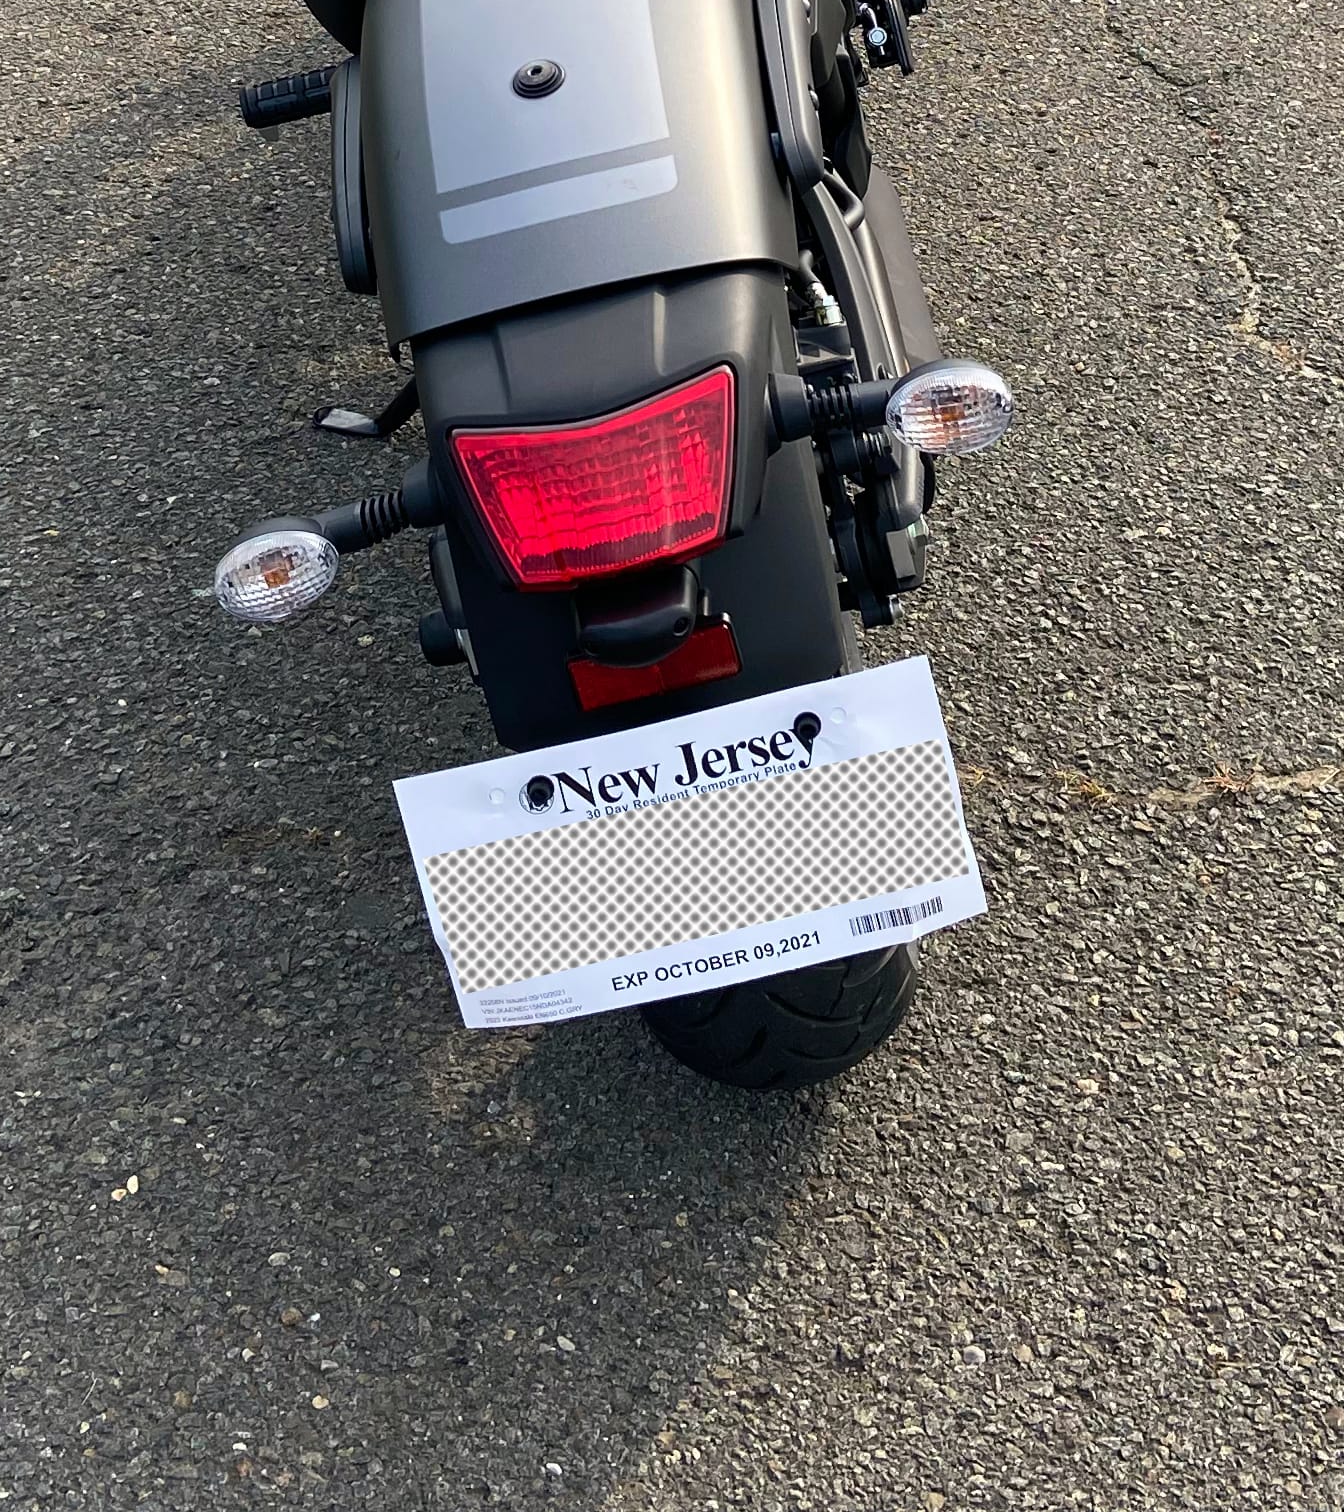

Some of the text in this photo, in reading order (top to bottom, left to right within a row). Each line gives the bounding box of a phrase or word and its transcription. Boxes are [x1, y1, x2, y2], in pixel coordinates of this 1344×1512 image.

[551, 726, 817, 814] New Jersey
[586, 762, 797, 820] 30 Day Resident Temporary Plate
[611, 930, 822, 991] EXP OCTOBER 09,2021
